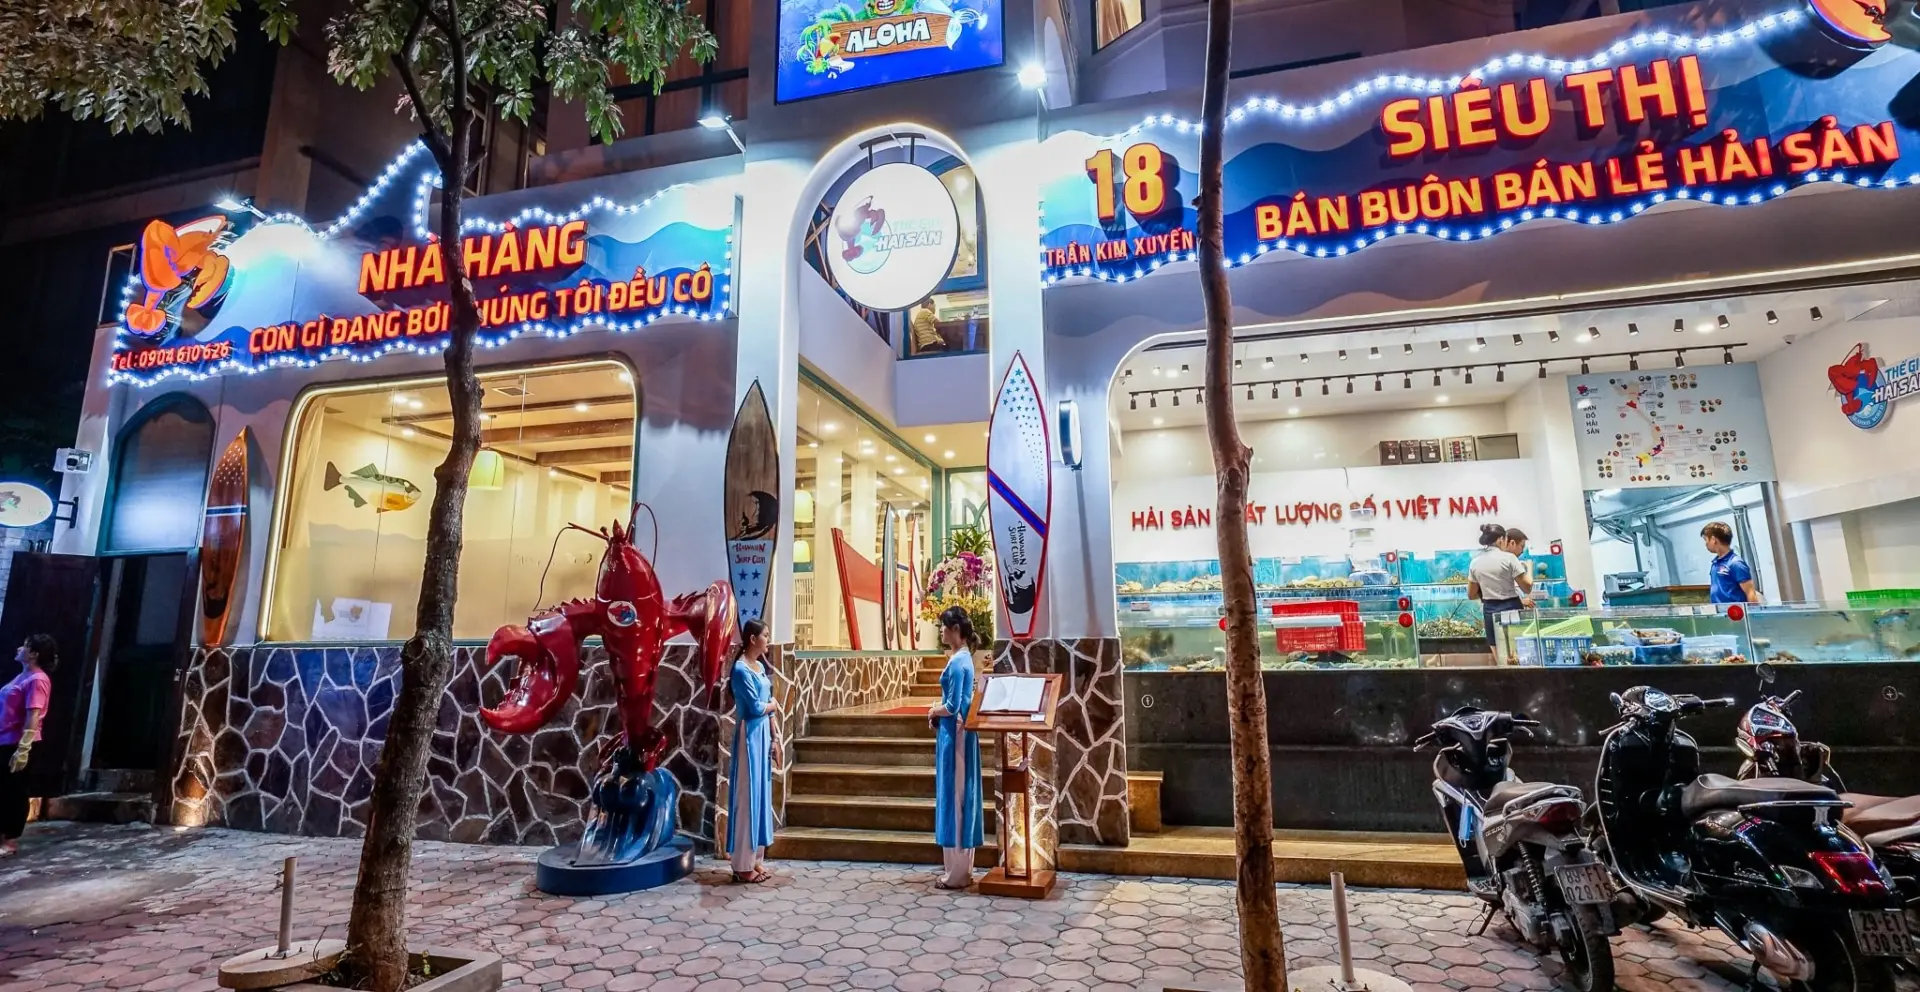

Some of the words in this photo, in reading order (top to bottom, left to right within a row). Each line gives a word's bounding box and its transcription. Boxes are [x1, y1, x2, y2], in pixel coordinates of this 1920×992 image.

[845, 17, 931, 53] ALOHA
[1381, 74, 1551, 157] SIÊU
[1564, 54, 1707, 129] THỊ
[1085, 142, 1165, 219] 18
[1255, 191, 1350, 241] BÁN
[1360, 173, 1484, 228] BUÔN
[1494, 158, 1597, 211] BÁN
[1606, 140, 1668, 195] LẺ
[1677, 128, 1773, 186] HẢI
[1780, 114, 1899, 174] SẢN
[358, 232, 444, 294] NHÀ
[461, 220, 589, 277] HÀNG
[1045, 241, 1090, 267] TRẦN
[1096, 239, 1128, 262] KIM
[1134, 227, 1194, 257] XUYẾN
[249, 323, 297, 354] CON
[301, 312, 327, 347] GÌ
[331, 311, 401, 344] ĐANG
[406, 300, 450, 335] BƠI
[474, 284, 547, 327] HÚNG
[555, 279, 600, 317] TÔI
[608, 265, 666, 310] ĐỀU
[673, 261, 713, 302] CÓ
[177, 344, 200, 363] 610
[202, 340, 230, 360] 626
[1275, 501, 1343, 527] LƯỢNG
[1396, 494, 1441, 521] VIỆT
[1449, 495, 1498, 518] NAM
